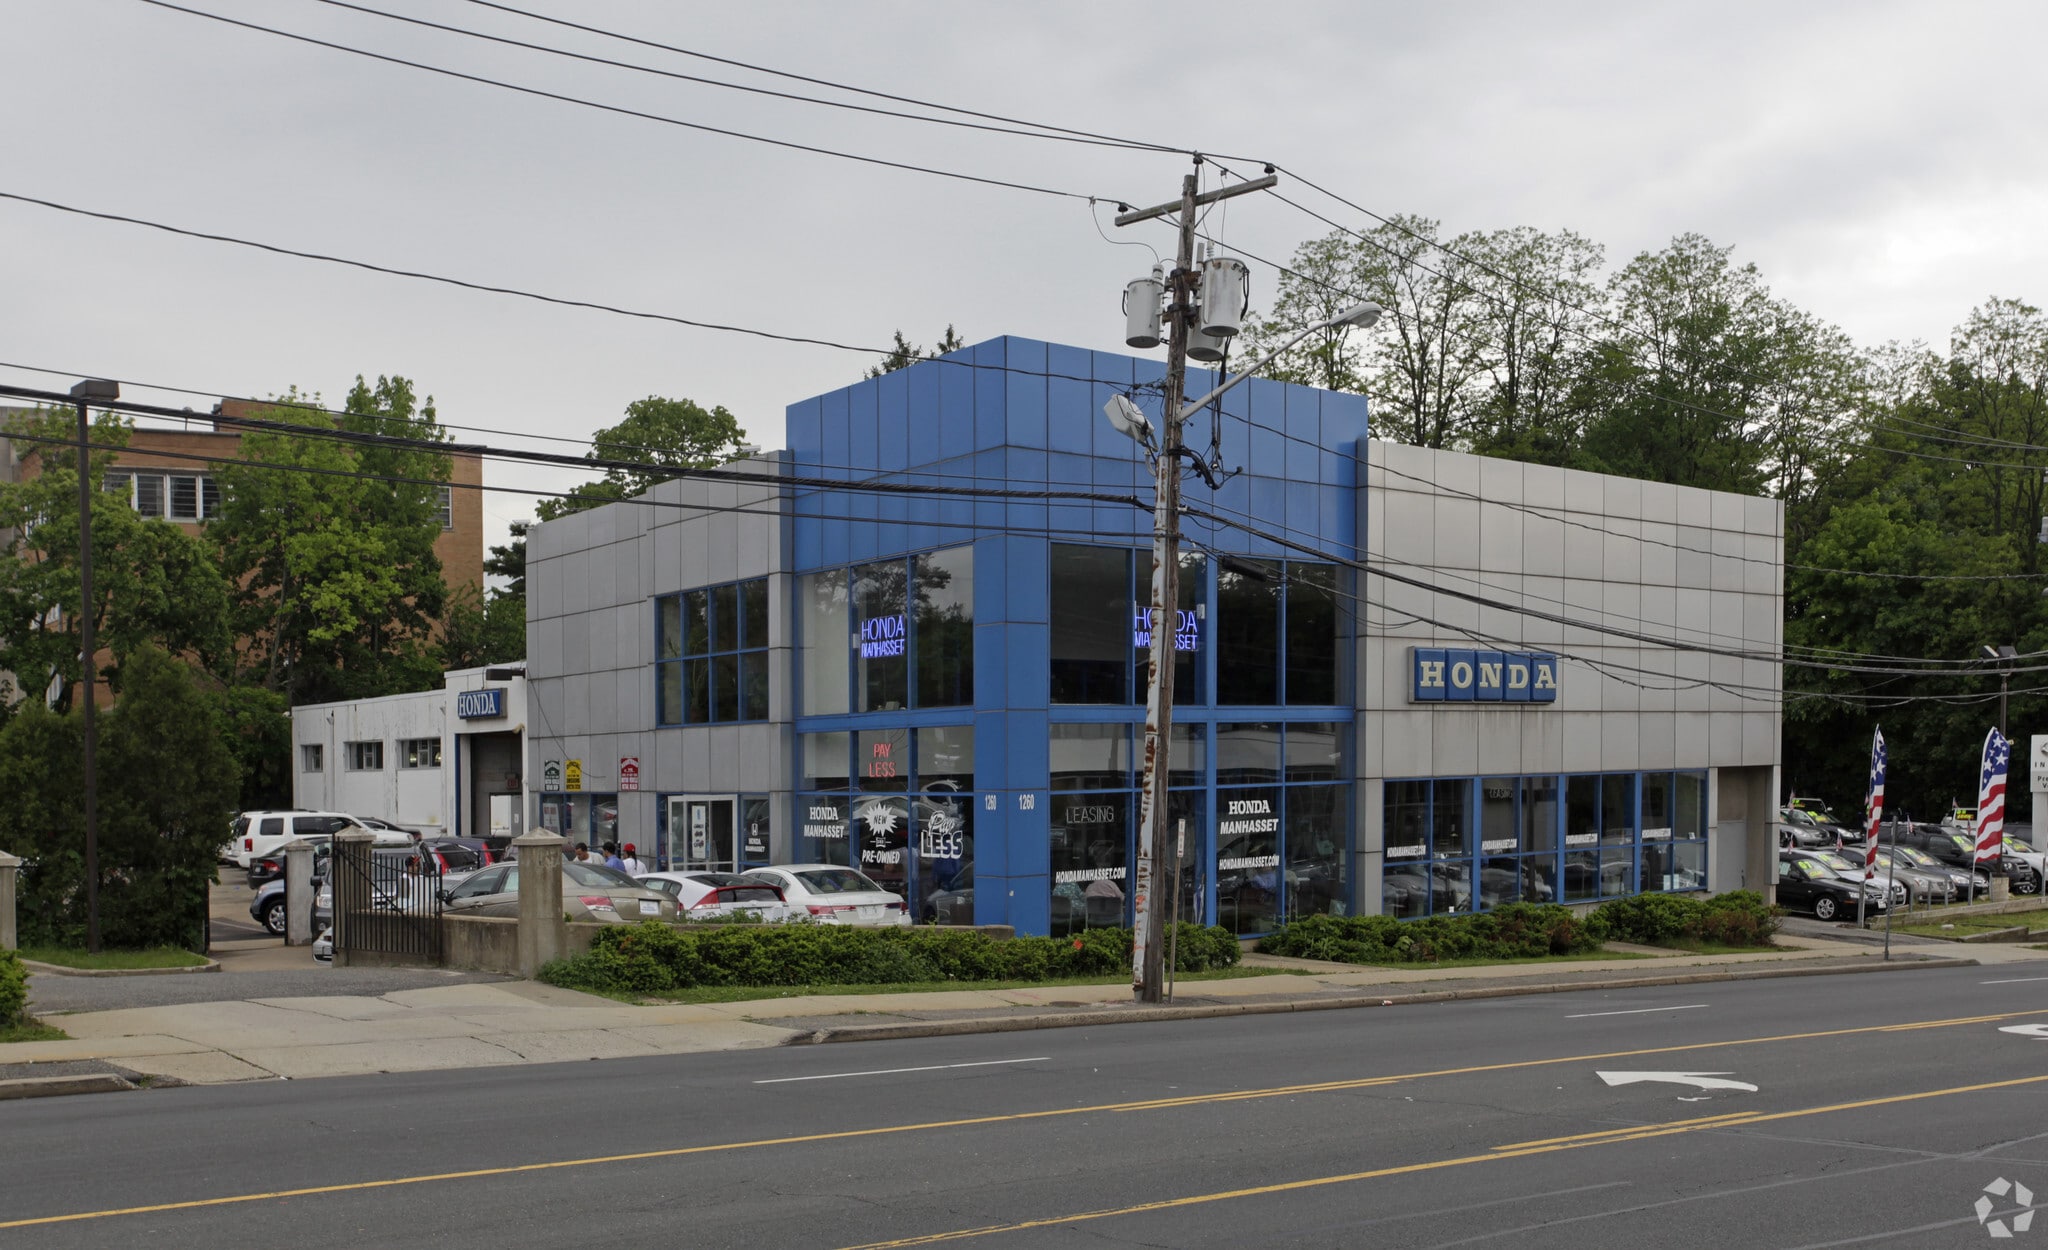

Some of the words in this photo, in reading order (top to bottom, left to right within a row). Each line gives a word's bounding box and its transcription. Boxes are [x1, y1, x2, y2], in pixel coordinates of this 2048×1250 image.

[861, 615, 905, 641] HONDA
[1134, 607, 1198, 633] HODA
[861, 639, 905, 658] MANHASSET
[1134, 631, 1198, 650] MASSET
[1419, 660, 1556, 689] HONDA
[458, 692, 496, 717] HONDA
[873, 743, 892, 758] PAY
[868, 762, 896, 778] LESS
[984, 794, 997, 811] 1260
[1018, 793, 1035, 811] 1260
[1228, 799, 1271, 815] HONDA
[809, 806, 838, 821] HONDA
[873, 814, 888, 825] NEW
[1066, 806, 1114, 824] LEASING
[803, 824, 844, 839] MANHASSET
[1220, 818, 1279, 835] MANHASSET
[920, 829, 964, 859] LESS
[861, 849, 901, 864] PRE-OWNED
[1218, 854, 1280, 871] HONDAMANHASSET.COM
[1055, 866, 1127, 884] HONDAMANHASSET.COM
